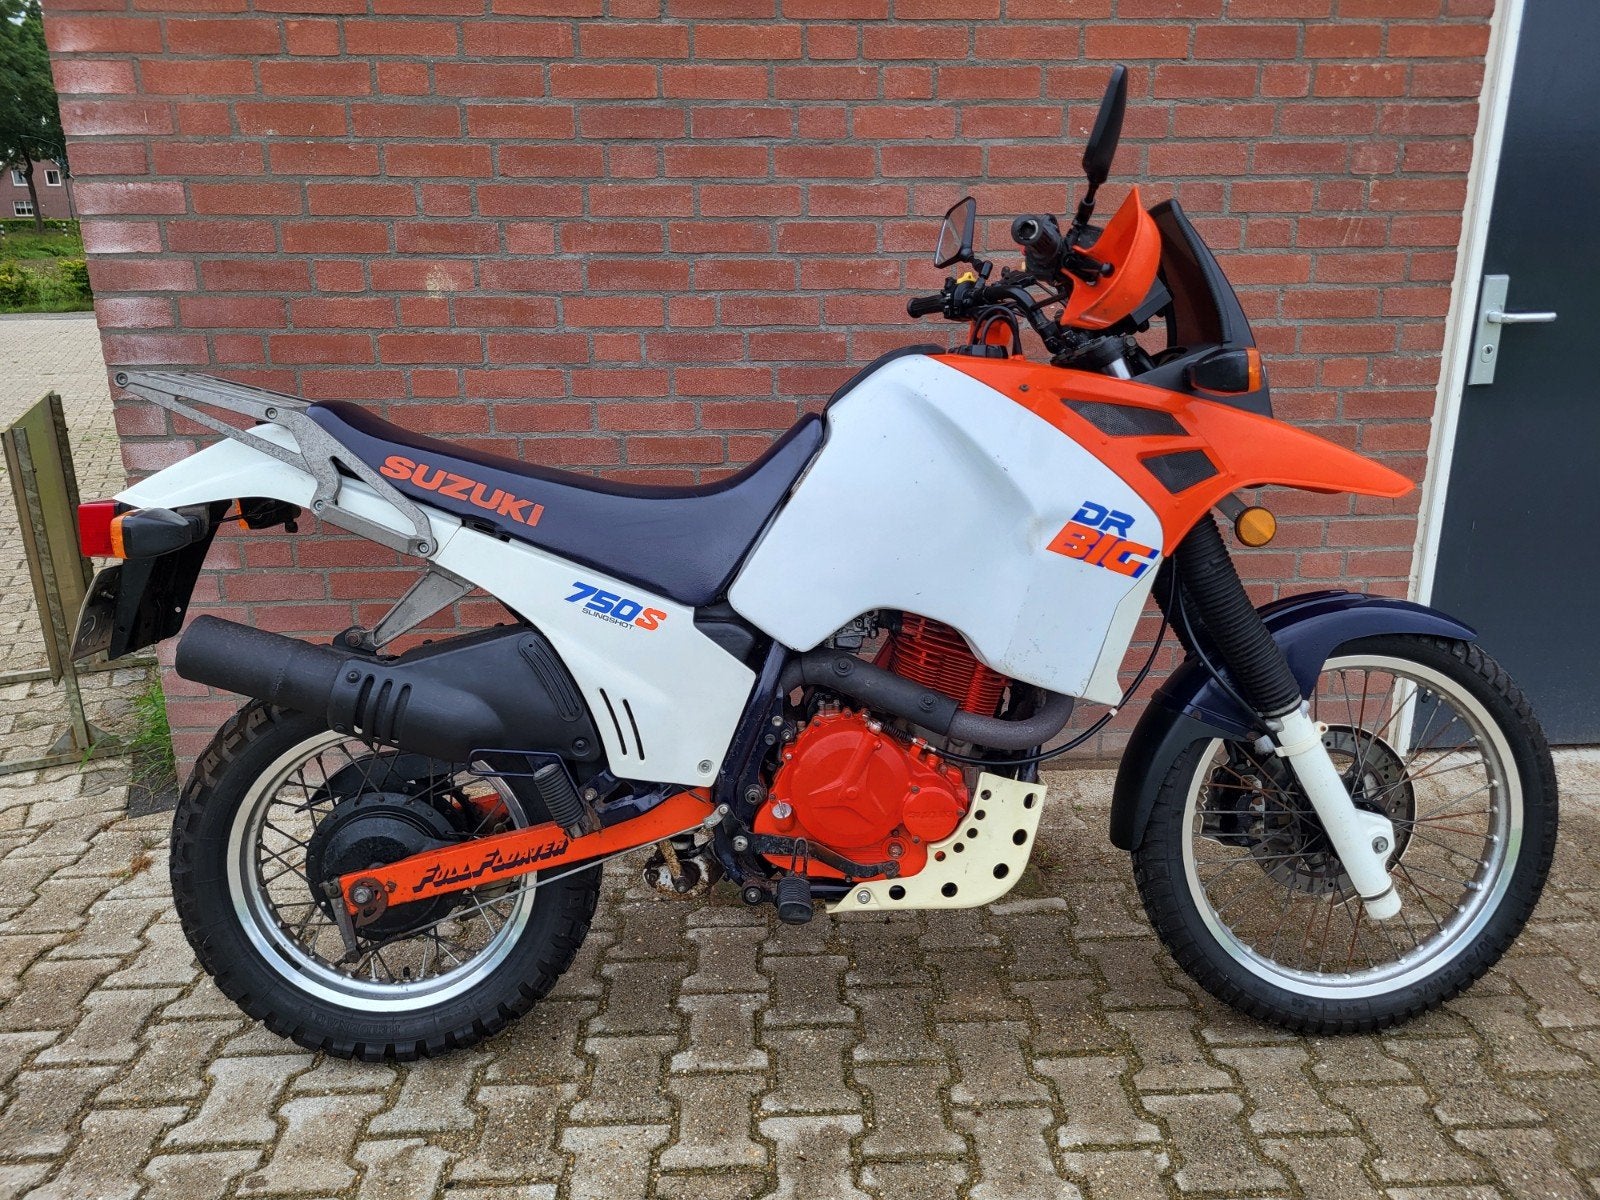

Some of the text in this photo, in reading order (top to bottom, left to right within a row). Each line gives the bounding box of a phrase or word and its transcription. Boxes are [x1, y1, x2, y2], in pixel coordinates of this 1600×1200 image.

[379, 455, 545, 527] SUZUKI
[1071, 500, 1136, 538] DR
[1045, 521, 1160, 579] BIG
[564, 581, 668, 631] 750S
[581, 607, 635, 630] SLINGSHOT
[412, 838, 569, 893] FULL FLOATER
